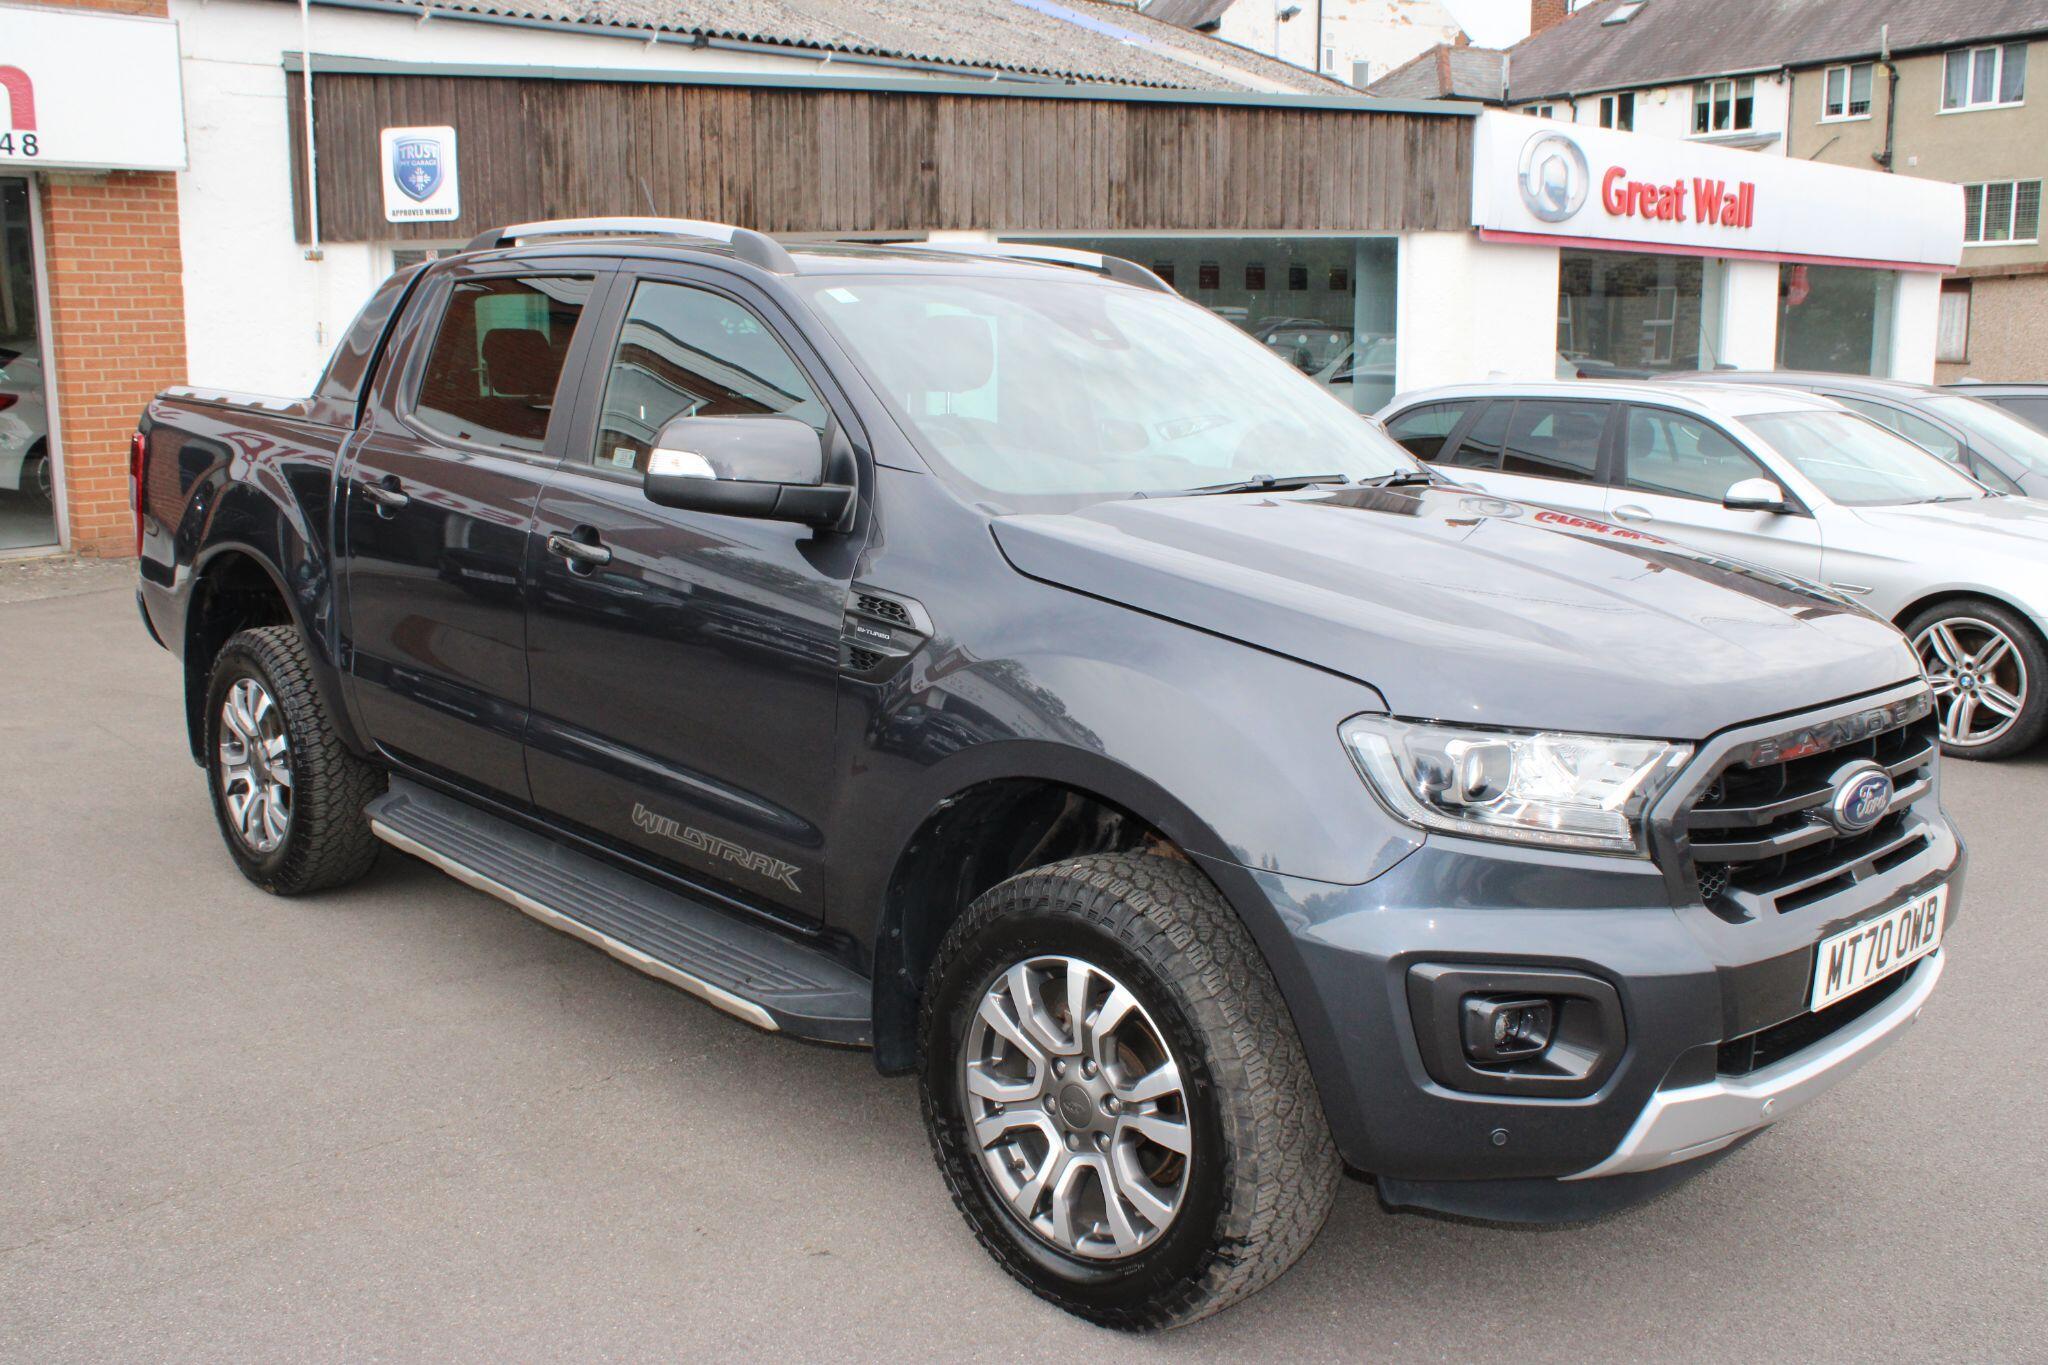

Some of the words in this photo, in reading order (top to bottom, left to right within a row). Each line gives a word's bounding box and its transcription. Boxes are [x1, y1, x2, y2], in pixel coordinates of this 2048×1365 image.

[399, 143, 438, 159] TRUST
[391, 208, 424, 217] APPROVED
[425, 207, 452, 215] MEMBER
[1601, 165, 1687, 222] Great
[1693, 176, 1755, 228] Wall
[857, 626, 890, 640] BI-TURBO
[1758, 694, 1928, 763] RANGER
[1856, 781, 1888, 819] Ford
[632, 802, 802, 893] WILDTRAK
[1825, 919, 1893, 996] MT70
[1896, 895, 1938, 958] OWB
